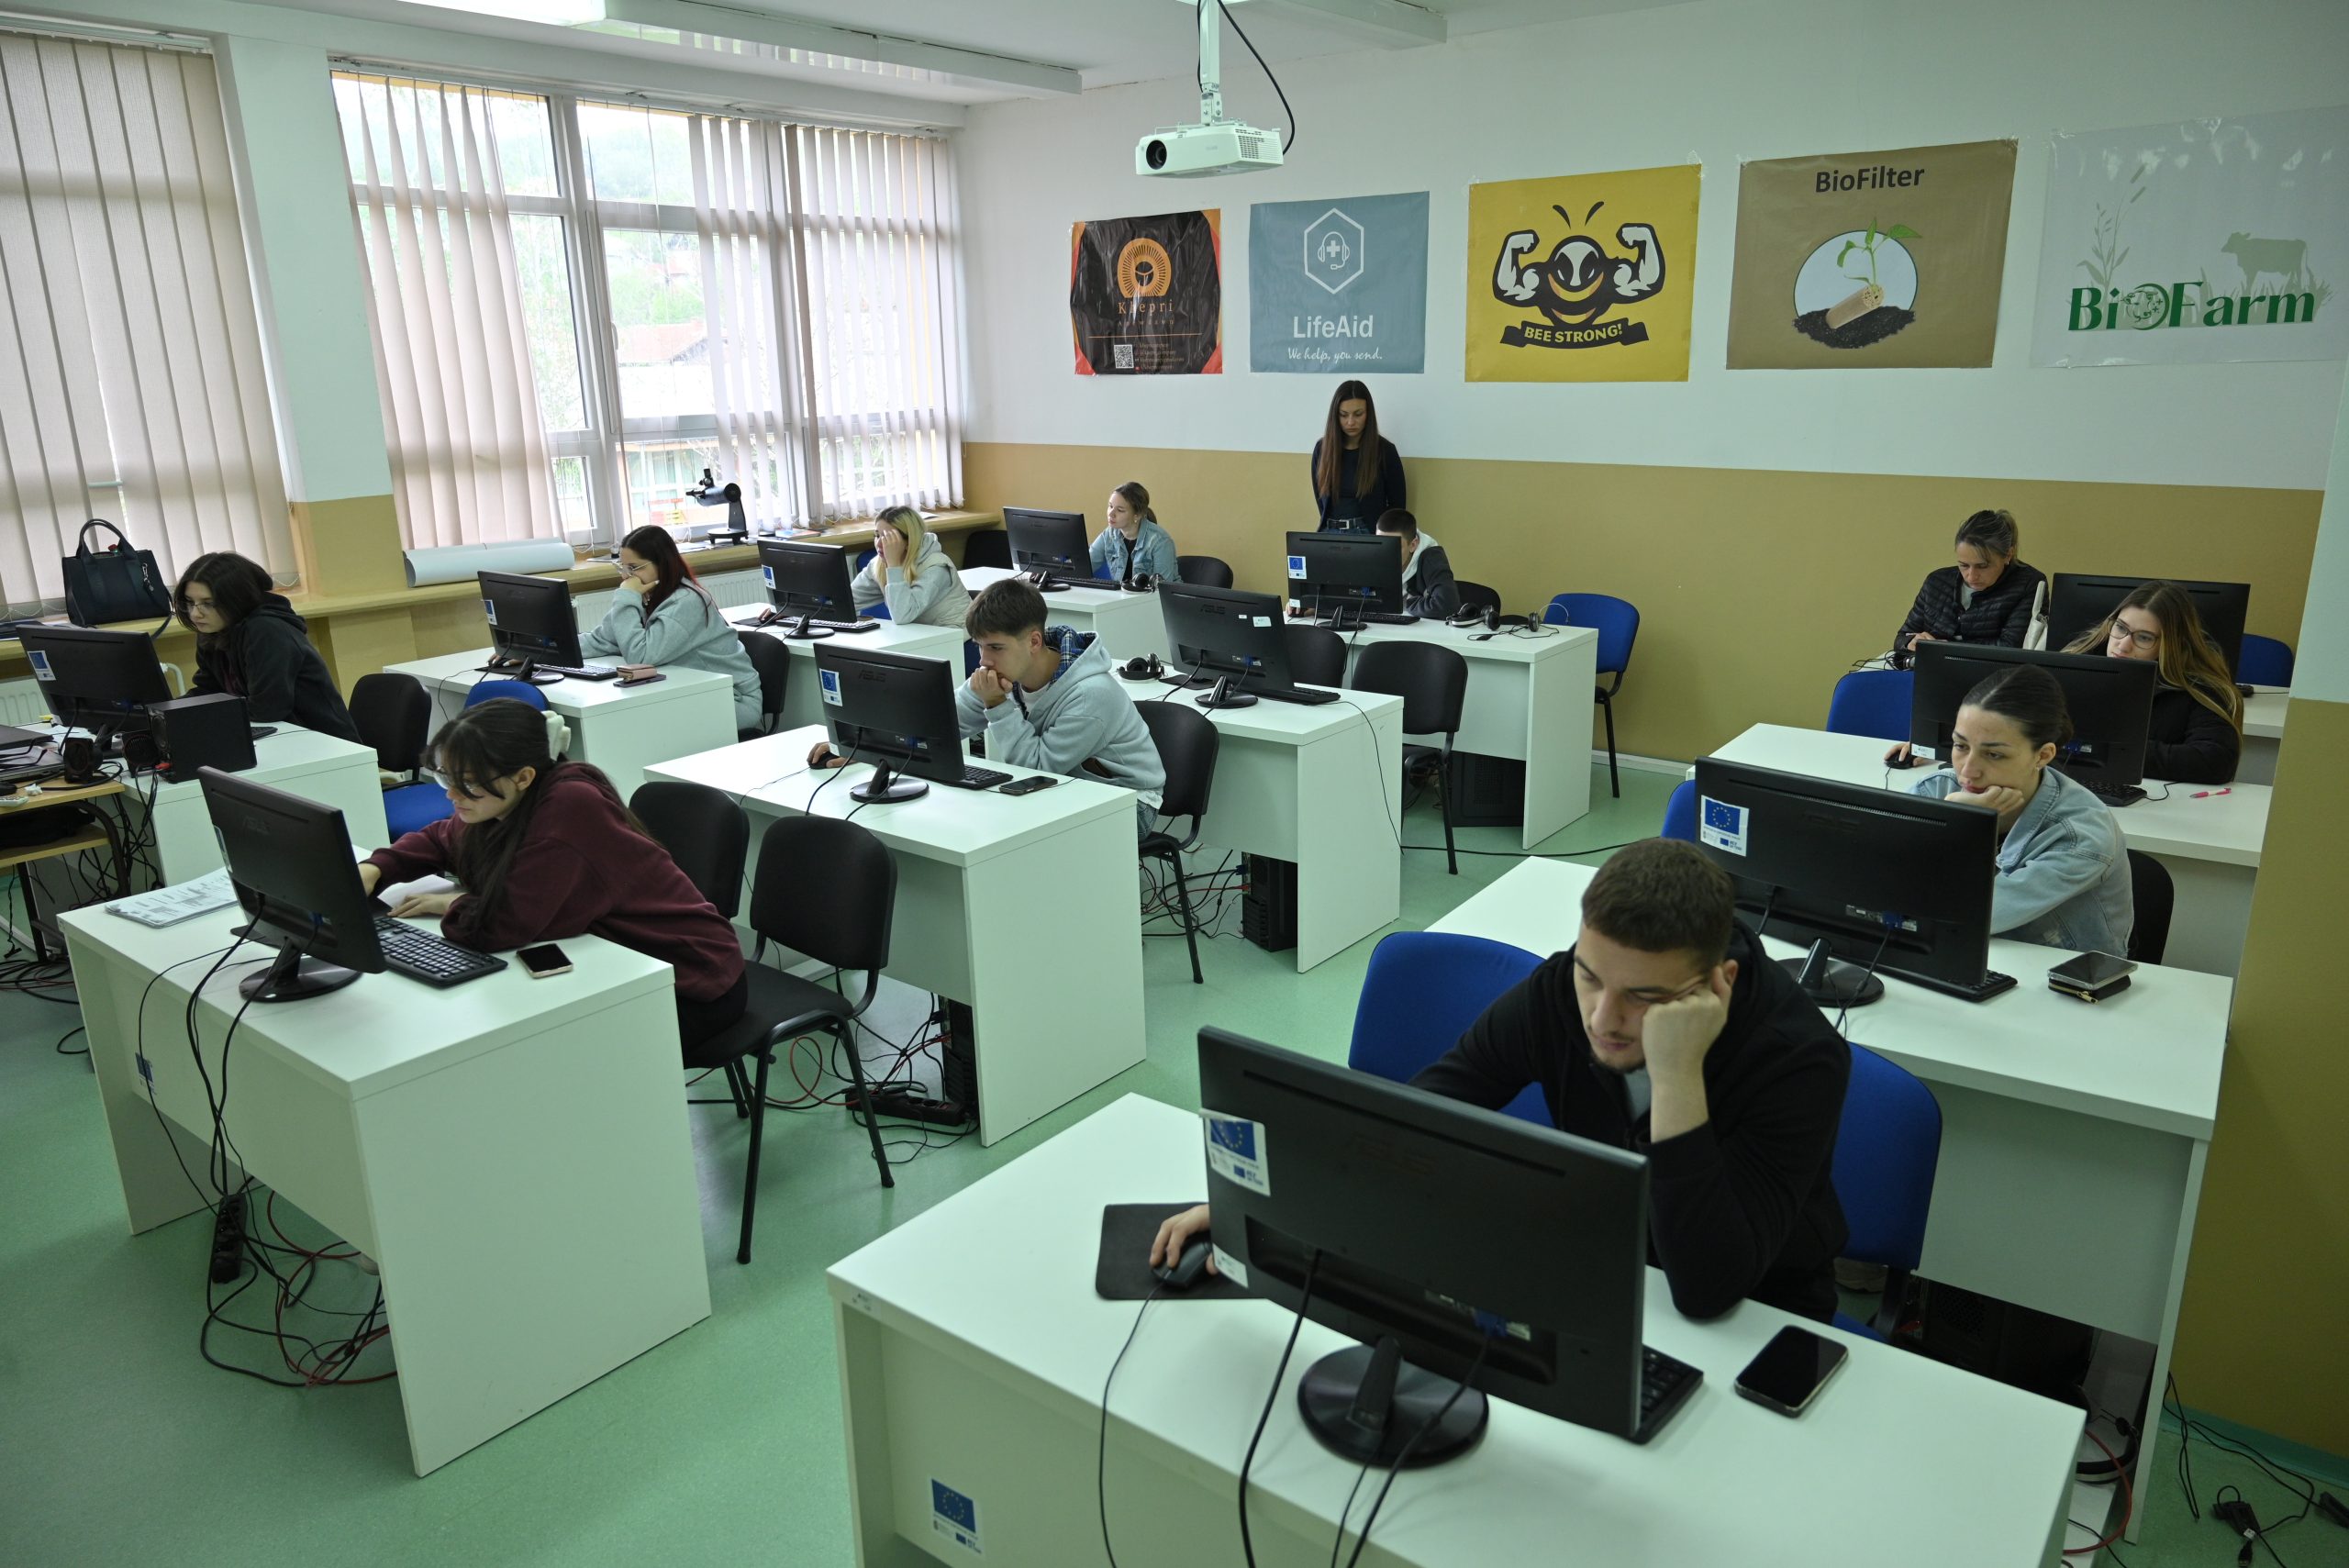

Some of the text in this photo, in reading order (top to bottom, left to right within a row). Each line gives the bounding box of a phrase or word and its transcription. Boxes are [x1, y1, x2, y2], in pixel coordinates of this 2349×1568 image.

[1815, 165, 1925, 193] BioFilter
[1293, 315, 1374, 339] LifeAid
[1523, 323, 1623, 343] BEE STRONG!
[1287, 347, 1302, 360] We
[1333, 352, 1352, 364] you
